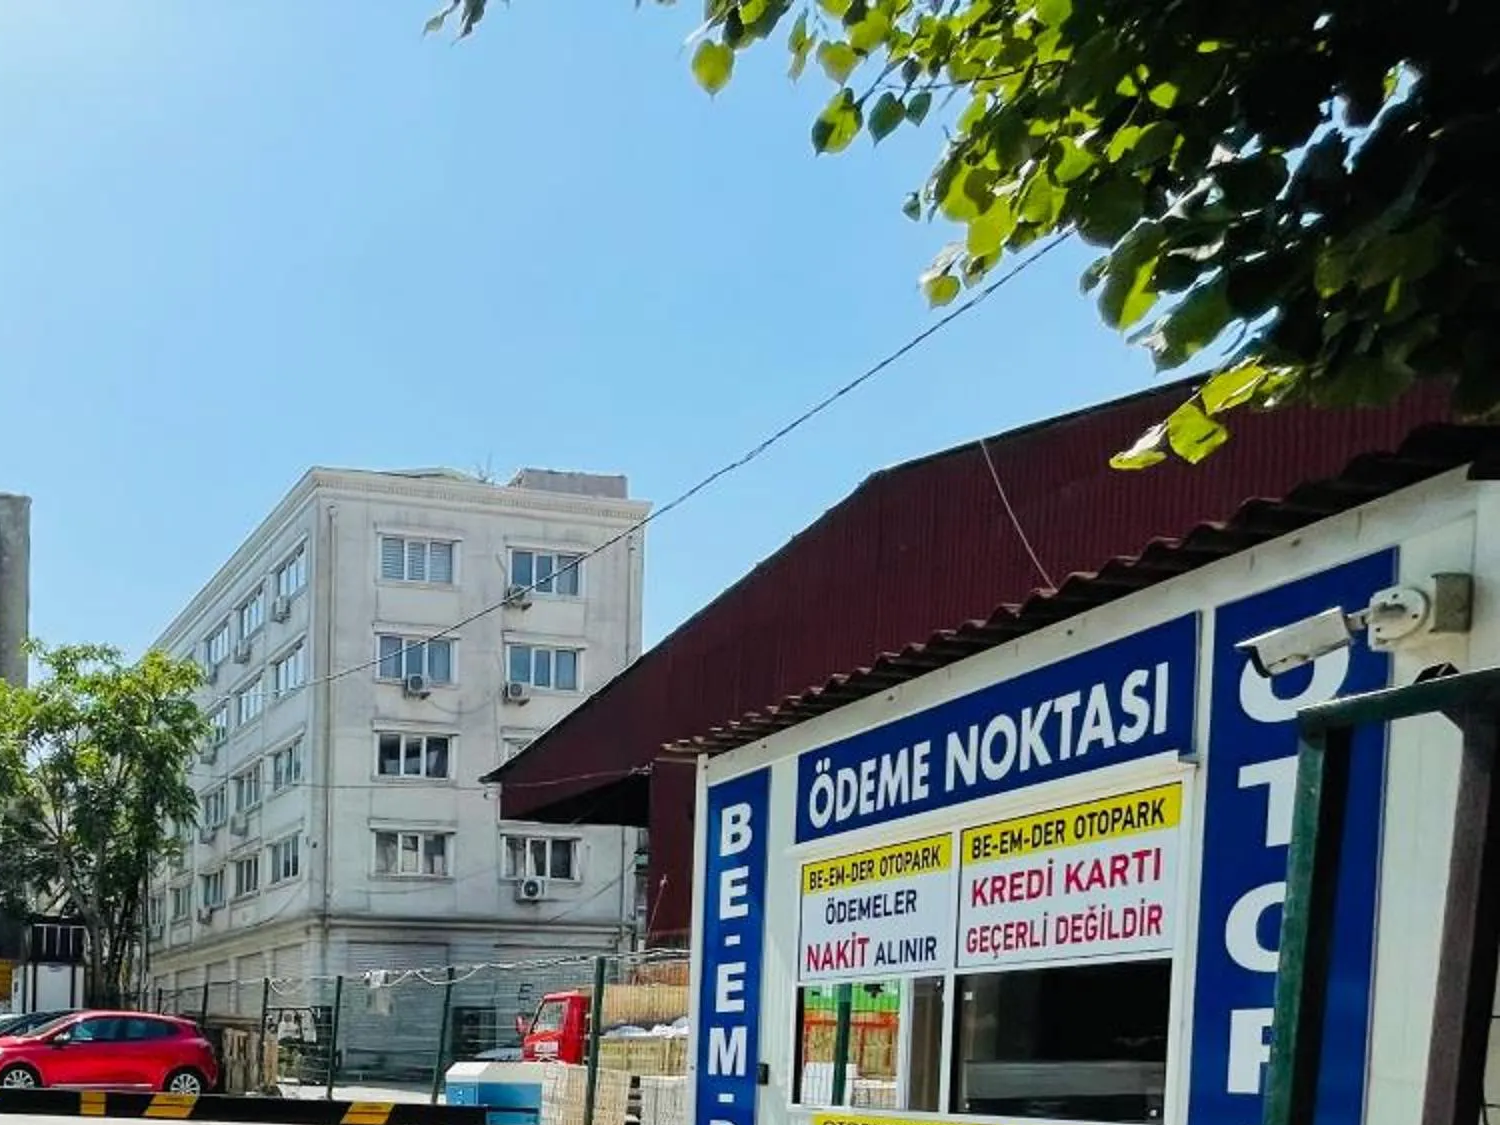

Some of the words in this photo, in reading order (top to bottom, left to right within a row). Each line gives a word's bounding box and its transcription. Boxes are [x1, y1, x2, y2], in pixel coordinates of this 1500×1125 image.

[809, 741, 931, 829] ÖDEME
[945, 661, 1169, 791] NOKTASI
[972, 821, 1065, 859] BE-EM-DER
[1074, 798, 1165, 840] OTOPARK
[809, 859, 875, 890] BE-EM-DER
[880, 844, 942, 877] OTOPARK
[972, 859, 1054, 908] KREDİ
[1064, 848, 1162, 895] KARTI
[825, 889, 918, 925] ÖDEMELER
[967, 912, 1048, 959] GEÇERLİ
[1055, 898, 1163, 945] DEĞİLDİR
[806, 931, 871, 972] NAKİT
[875, 936, 938, 965] ALINIR
